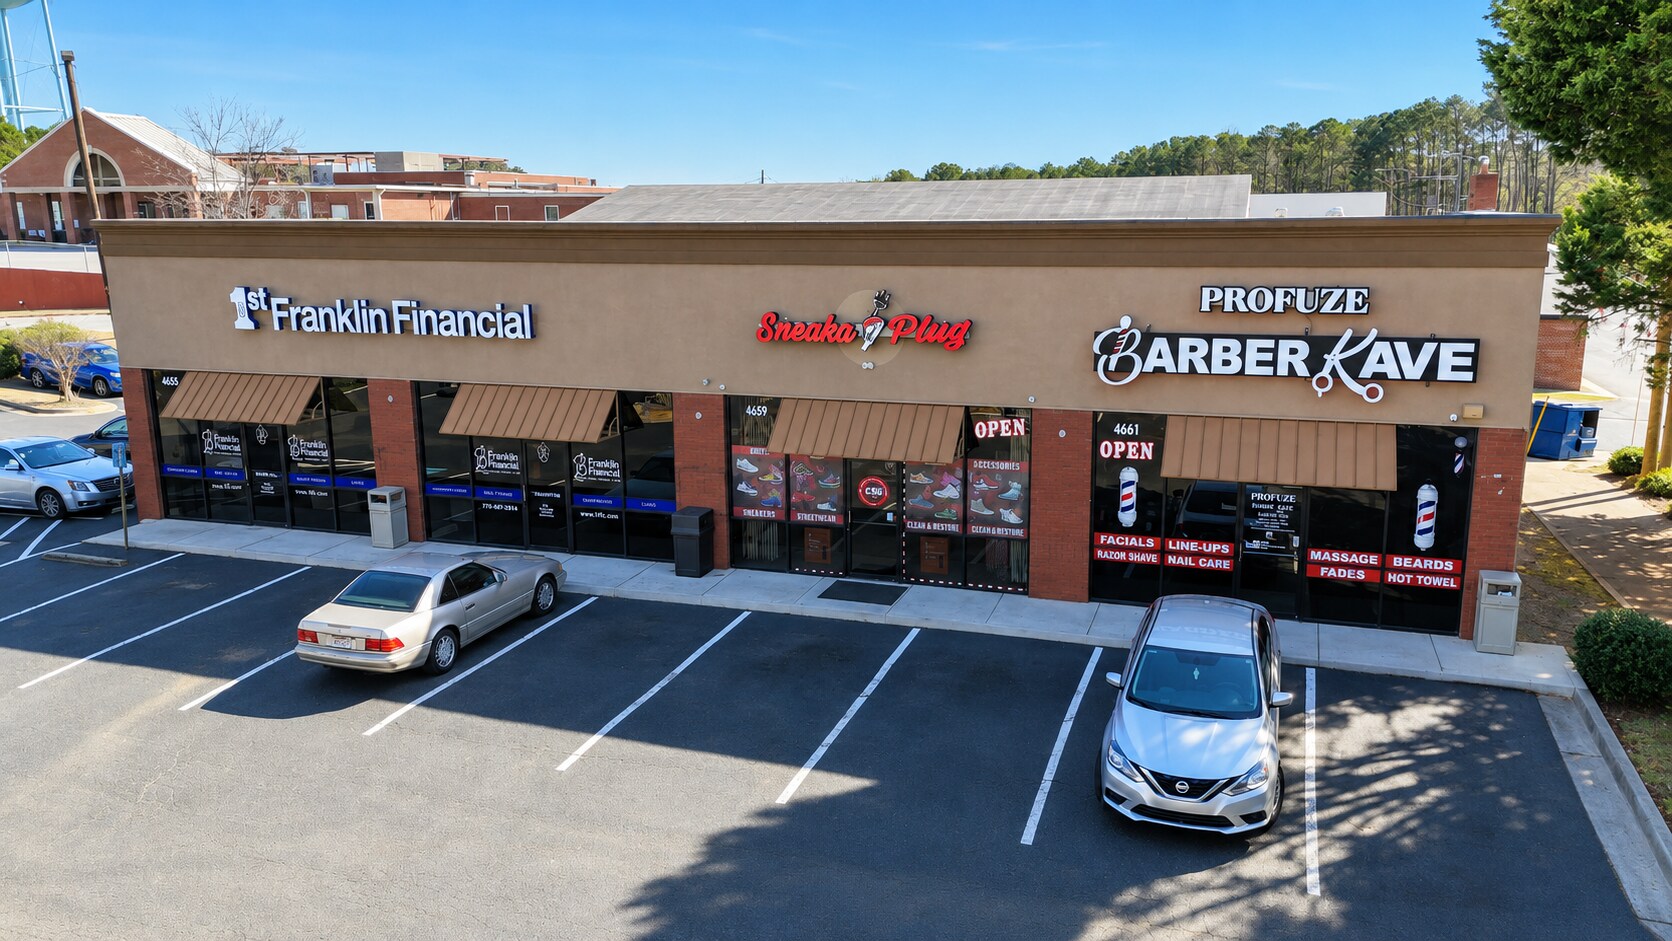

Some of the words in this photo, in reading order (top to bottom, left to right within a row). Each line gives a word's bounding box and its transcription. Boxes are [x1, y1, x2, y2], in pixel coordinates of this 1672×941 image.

[1200, 286, 1370, 314] PROFUZE
[229, 286, 270, 330] 1st
[270, 297, 392, 335] Franklin
[392, 300, 536, 339] Financial
[756, 311, 859, 343] Sneaka
[887, 313, 973, 351] Plug
[1092, 315, 1310, 386] BARBER
[1311, 327, 1476, 403] KAVE
[162, 376, 179, 386] 4655
[746, 405, 768, 417] 4659
[974, 418, 1025, 439] OPEN
[1113, 423, 1140, 436] 4661
[1100, 440, 1154, 460] OPEN
[1251, 492, 1296, 503] PROFUZE
[1100, 535, 1155, 548] FACIALS
[1168, 540, 1230, 554] LINE-UPS
[1097, 551, 1126, 561] RAZOR
[1128, 553, 1158, 563] SHAVE
[1167, 556, 1195, 566] NAIL
[1199, 558, 1231, 569] CARE
[1310, 550, 1378, 565] MASSAGE
[1393, 557, 1454, 571] BEARDS
[1320, 567, 1366, 580] FADES
[1387, 573, 1413, 584] HOT
[1416, 575, 1457, 588] TOWEL
